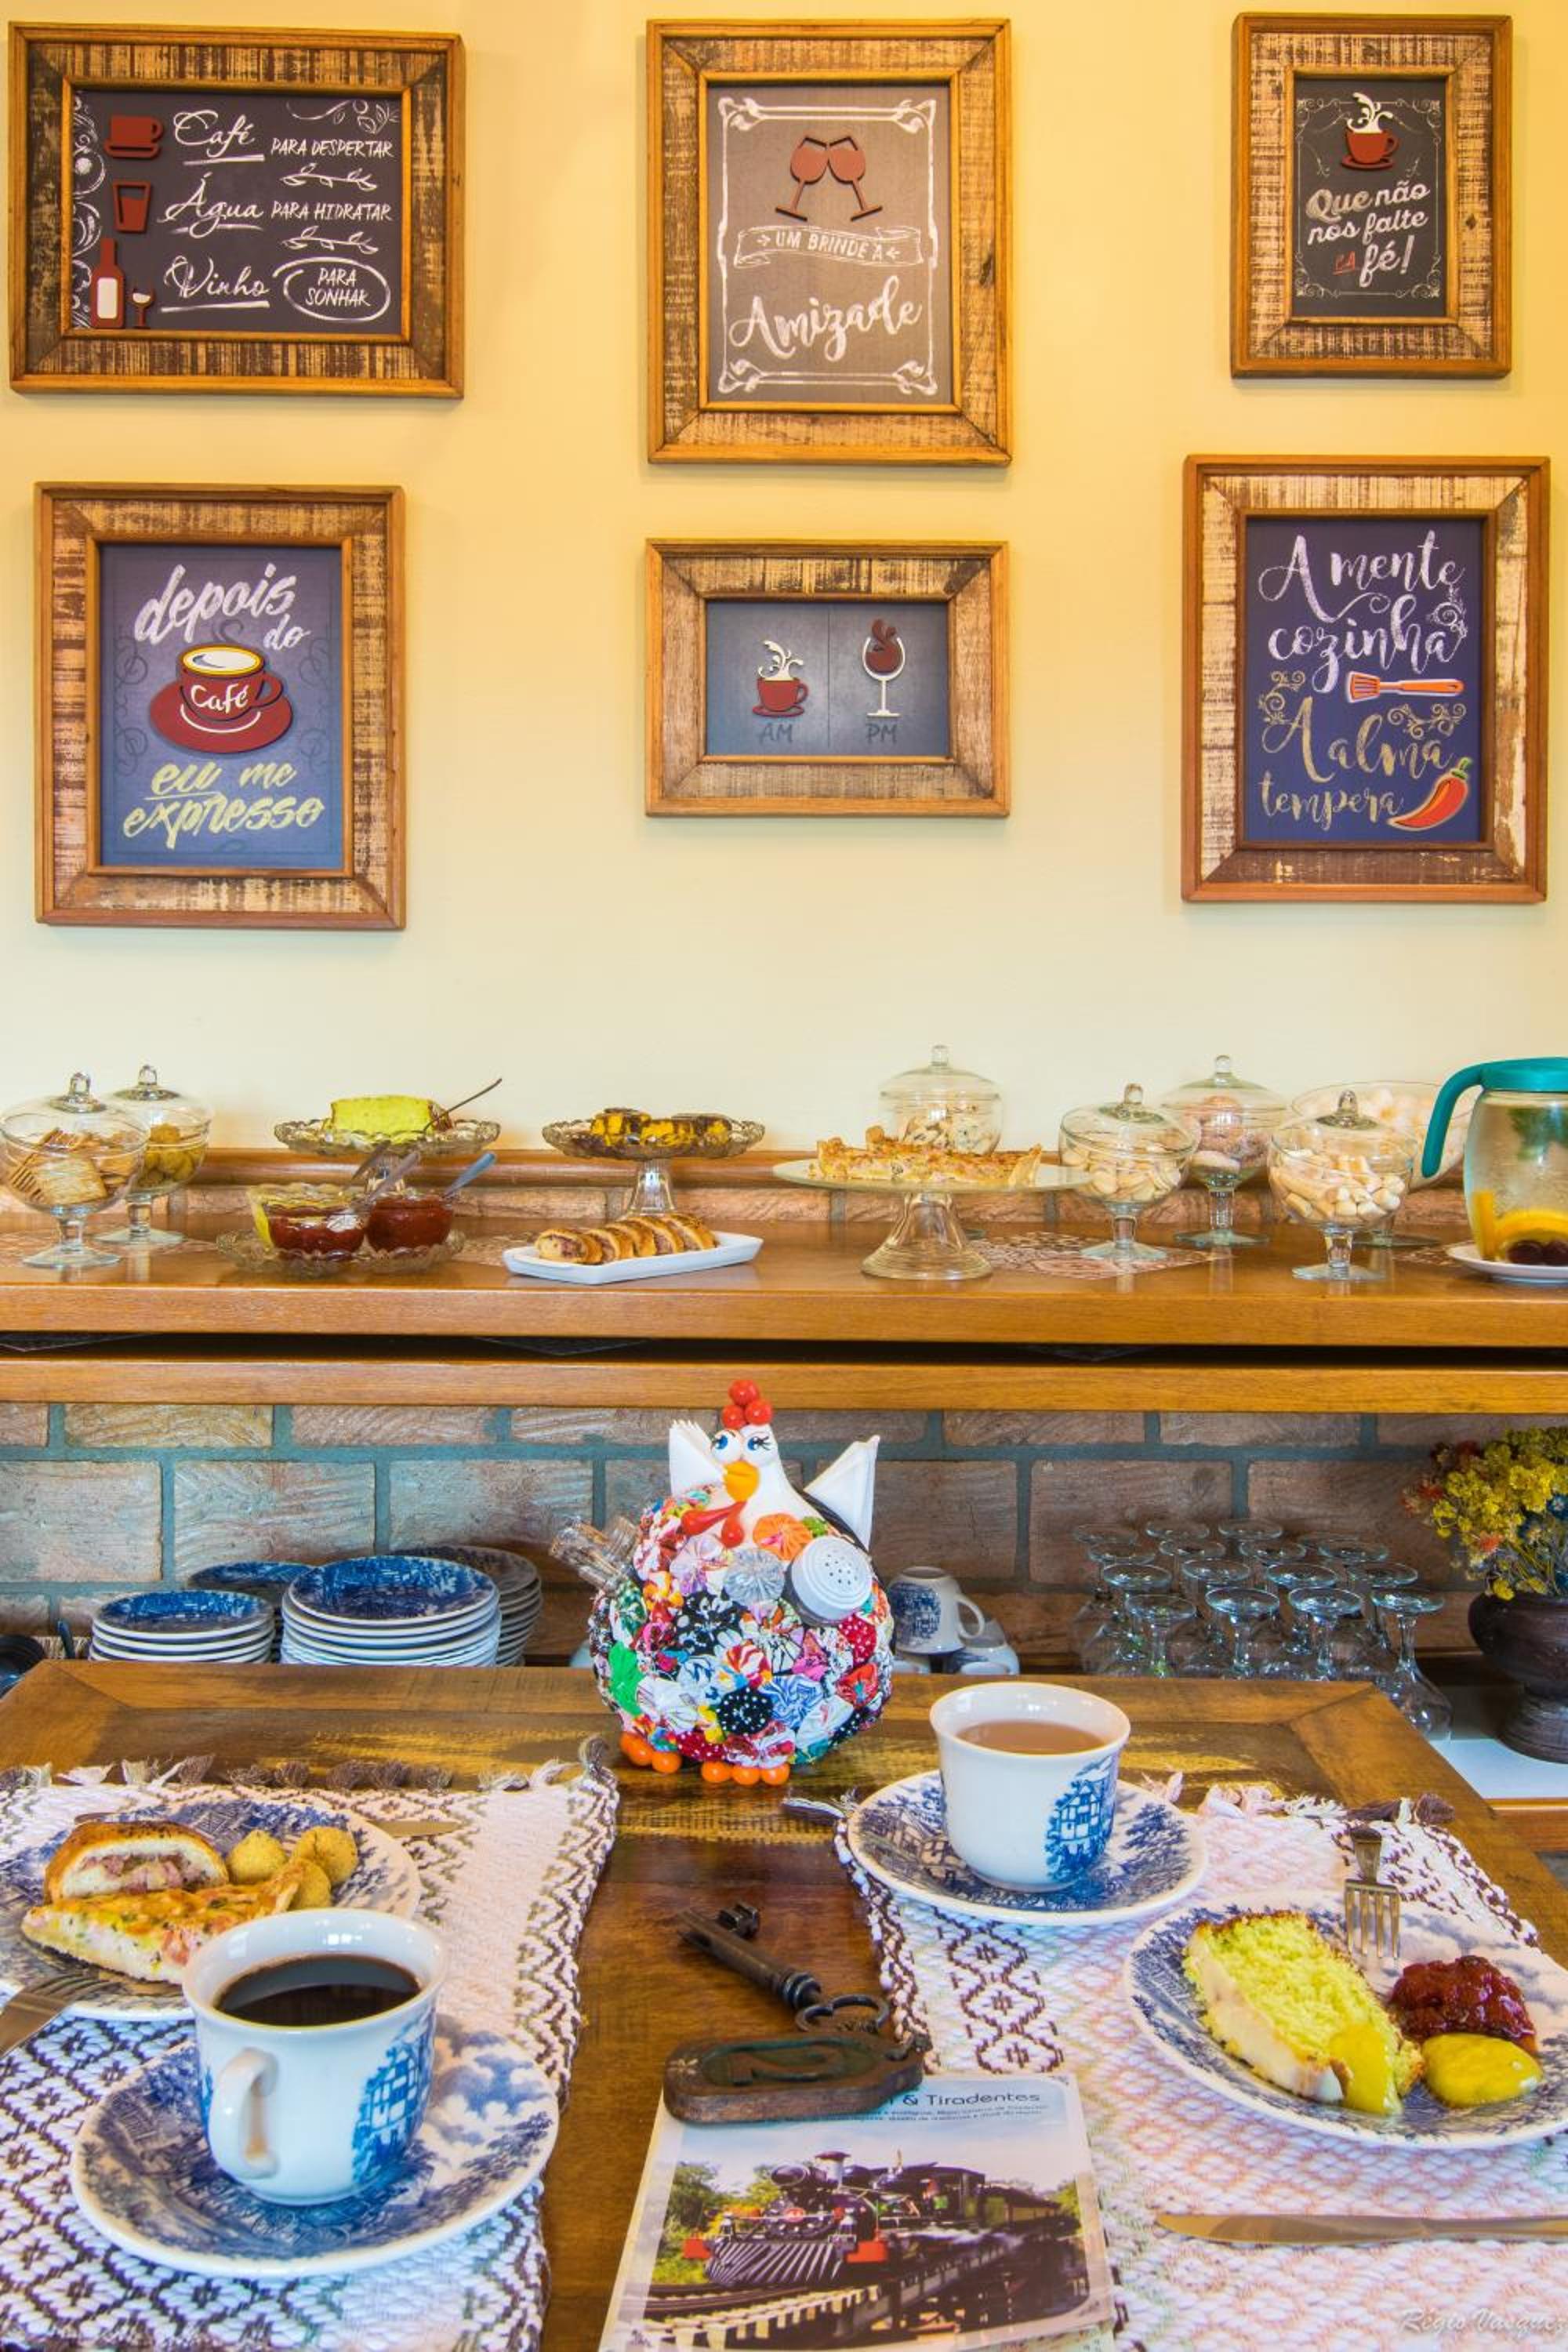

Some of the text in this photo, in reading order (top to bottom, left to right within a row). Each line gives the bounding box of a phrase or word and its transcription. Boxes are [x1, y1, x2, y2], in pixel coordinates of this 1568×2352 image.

[173, 109, 256, 157] Café
[271, 138, 393, 157] PARA DESPERTAR
[157, 172, 264, 238] Água
[271, 200, 392, 220] PARA HIDRATAR
[1306, 180, 1430, 223] Que não
[775, 231, 801, 249] UM
[808, 234, 869, 260] BRINDE
[1307, 210, 1428, 245] nos falte
[164, 255, 270, 298] Vinho
[318, 267, 357, 285] PARA
[1359, 235, 1415, 288] fé!
[305, 288, 372, 307] SONHAR
[729, 275, 922, 361] Amizade
[1330, 529, 1465, 591] mente
[134, 563, 296, 644] depois
[263, 614, 311, 651] do
[1268, 593, 1465, 693] cozinha
[191, 684, 250, 713] Café
[760, 723, 793, 743] AM
[865, 723, 898, 743] PM
[1261, 696, 1453, 783] A alma
[151, 761, 298, 797] eu me
[123, 793, 325, 849] expresso
[1258, 770, 1404, 832] tempera
[902, 2092, 1041, 2106] & Tiradentes
